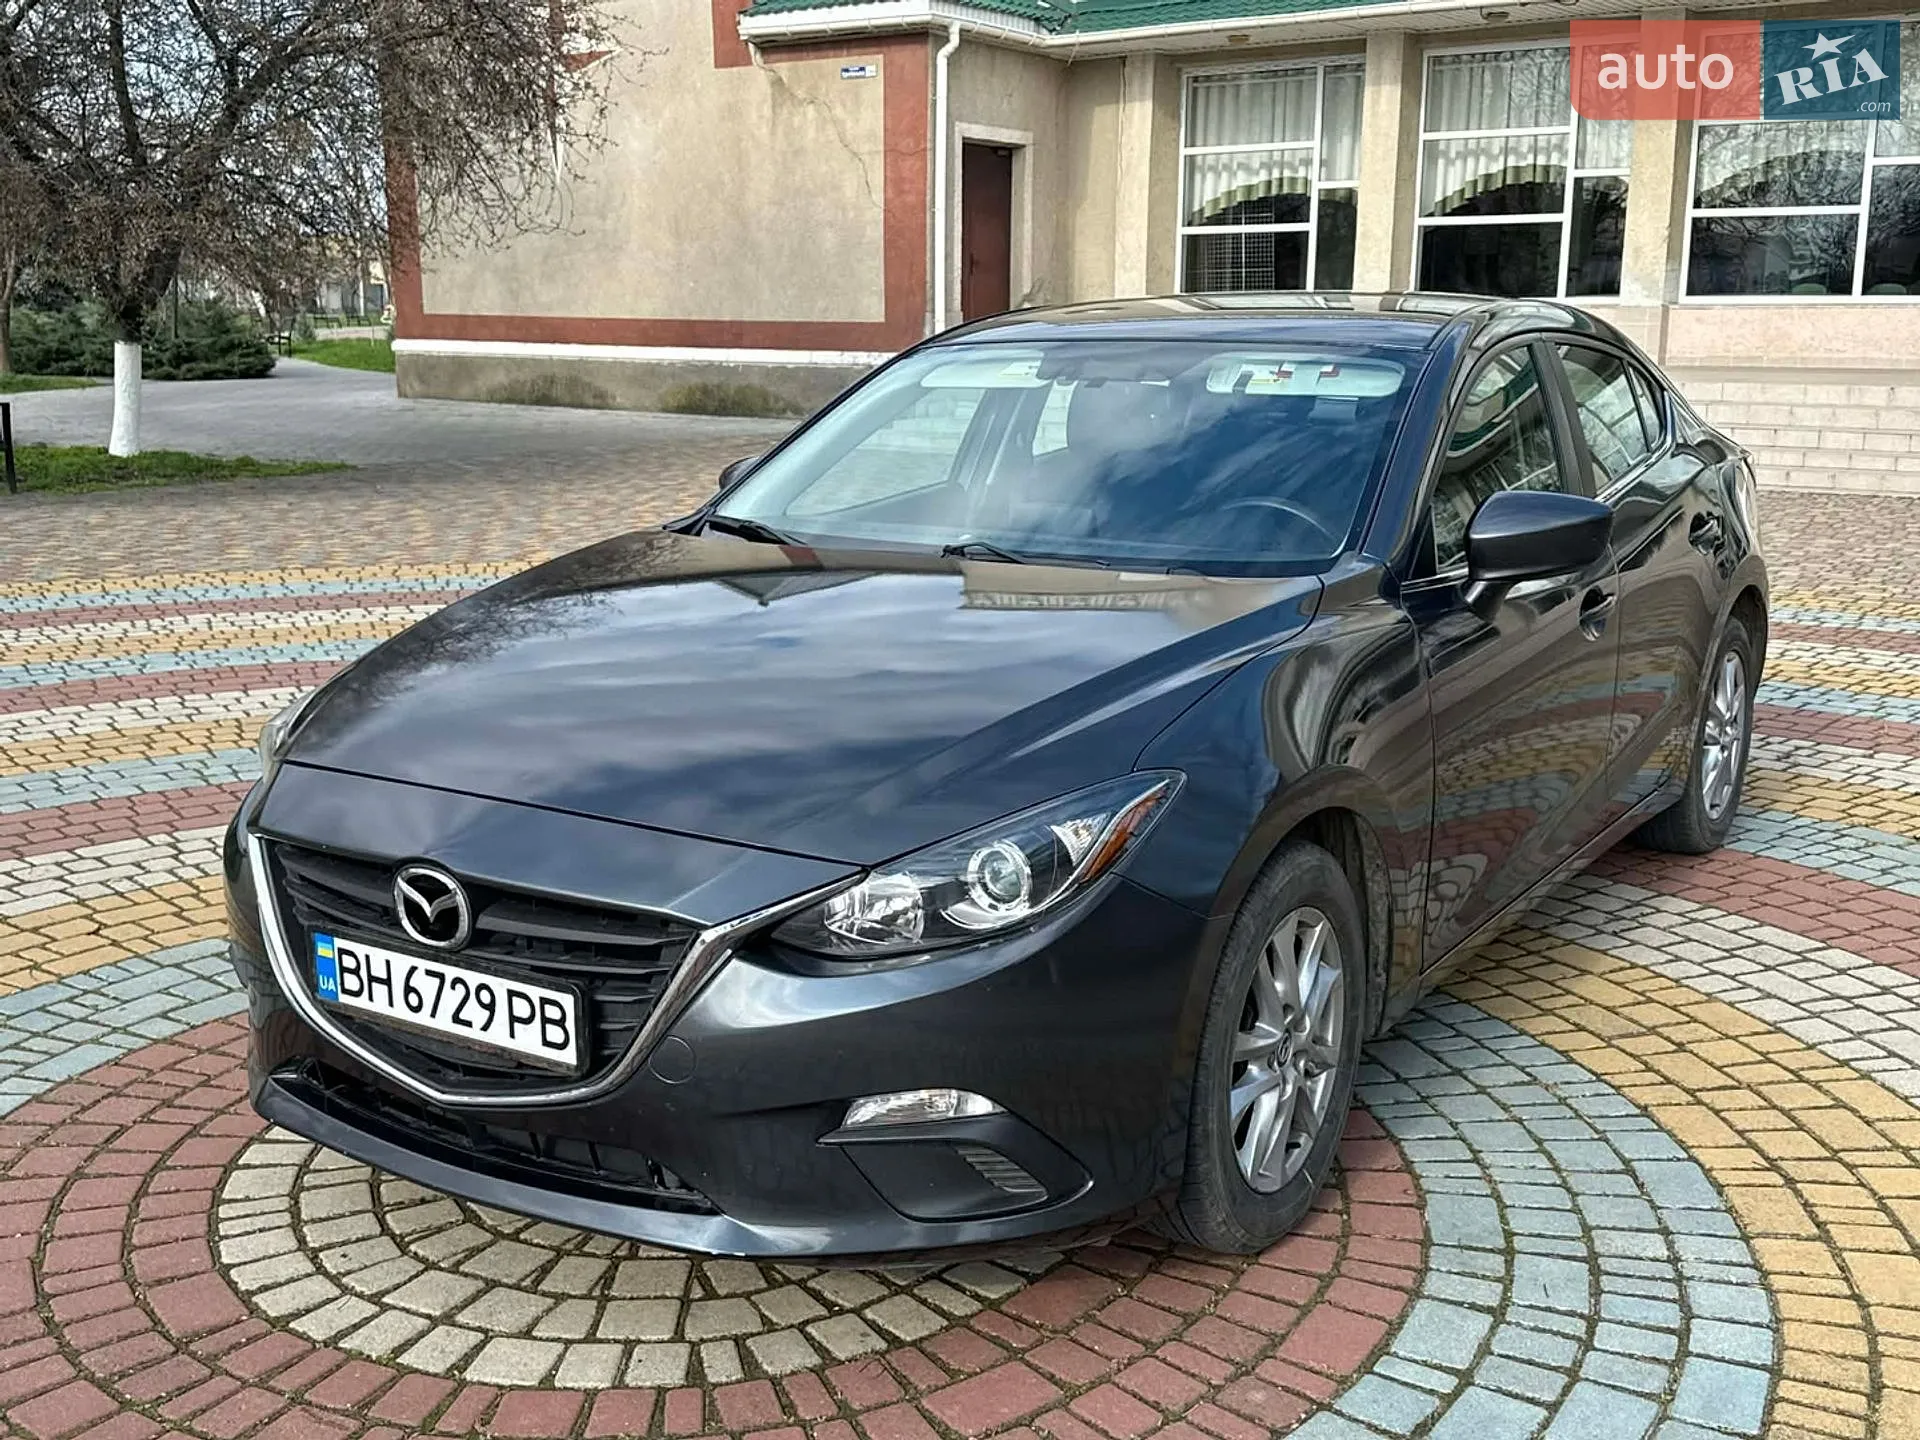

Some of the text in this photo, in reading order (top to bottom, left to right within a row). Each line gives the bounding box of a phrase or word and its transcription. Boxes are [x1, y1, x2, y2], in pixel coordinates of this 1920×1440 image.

[319, 976, 336, 992] UA
[337, 946, 570, 1051] BH 6729 PB
